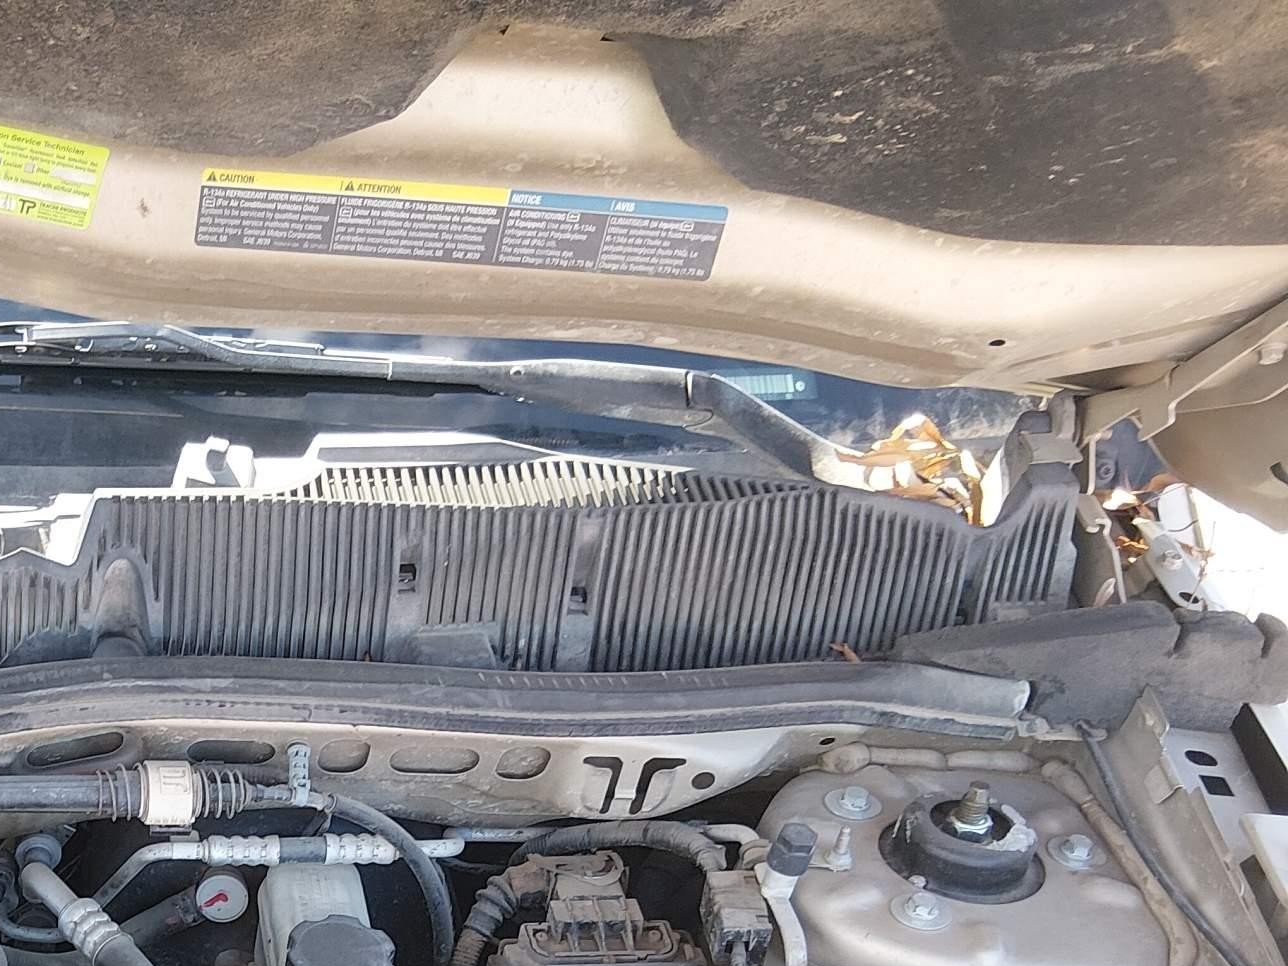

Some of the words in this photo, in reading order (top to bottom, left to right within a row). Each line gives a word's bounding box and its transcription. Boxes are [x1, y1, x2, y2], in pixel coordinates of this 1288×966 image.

[10, 134, 41, 146] Service
[44, 140, 85, 155] Technician
[219, 172, 254, 184] CAUTION
[357, 183, 401, 194] ATTENTION
[202, 186, 225, 197] R-134a
[225, 188, 267, 200] REFRIGERANT
[267, 192, 288, 201] UNDER
[289, 193, 304, 202] HIGH
[305, 194, 336, 204] PRESSURE
[511, 193, 542, 204] NOTICE
[215, 197, 229, 207] (For
[229, 198, 239, 206] Air
[239, 199, 276, 209] Conditioned
[276, 202, 302, 211] Vehicles
[302, 203, 319, 213] Only)
[341, 197, 363, 206] FLUIDE
[404, 201, 427, 210] R-134a
[427, 203, 444, 211] SOUS
[444, 204, 465, 213] HAUTE
[466, 206, 497, 215] PRESSION
[614, 201, 635, 212] AVIS
[200, 206, 223, 217] System
[239, 209, 265, 217] serviced
[273, 211, 299, 221] qualified
[300, 213, 329, 223] personnel
[353, 207, 370, 216] (pour
[410, 212, 425, 220] avec
[508, 209, 521, 217] AIR
[520, 209, 566, 221] CONDITIONING
[198, 224, 224, 234] personal
[243, 227, 265, 236] General
[266, 228, 287, 237] Motors
[290, 223, 303, 231] may
[355, 226, 385, 235] personnel
[558, 223, 572, 231] only
[572, 223, 596, 232] R-134a
[242, 236, 254, 244] SAE
[333, 242, 355, 250] General
[356, 242, 376, 251] Motors
[512, 247, 535, 255] system
[498, 254, 521, 263] System
